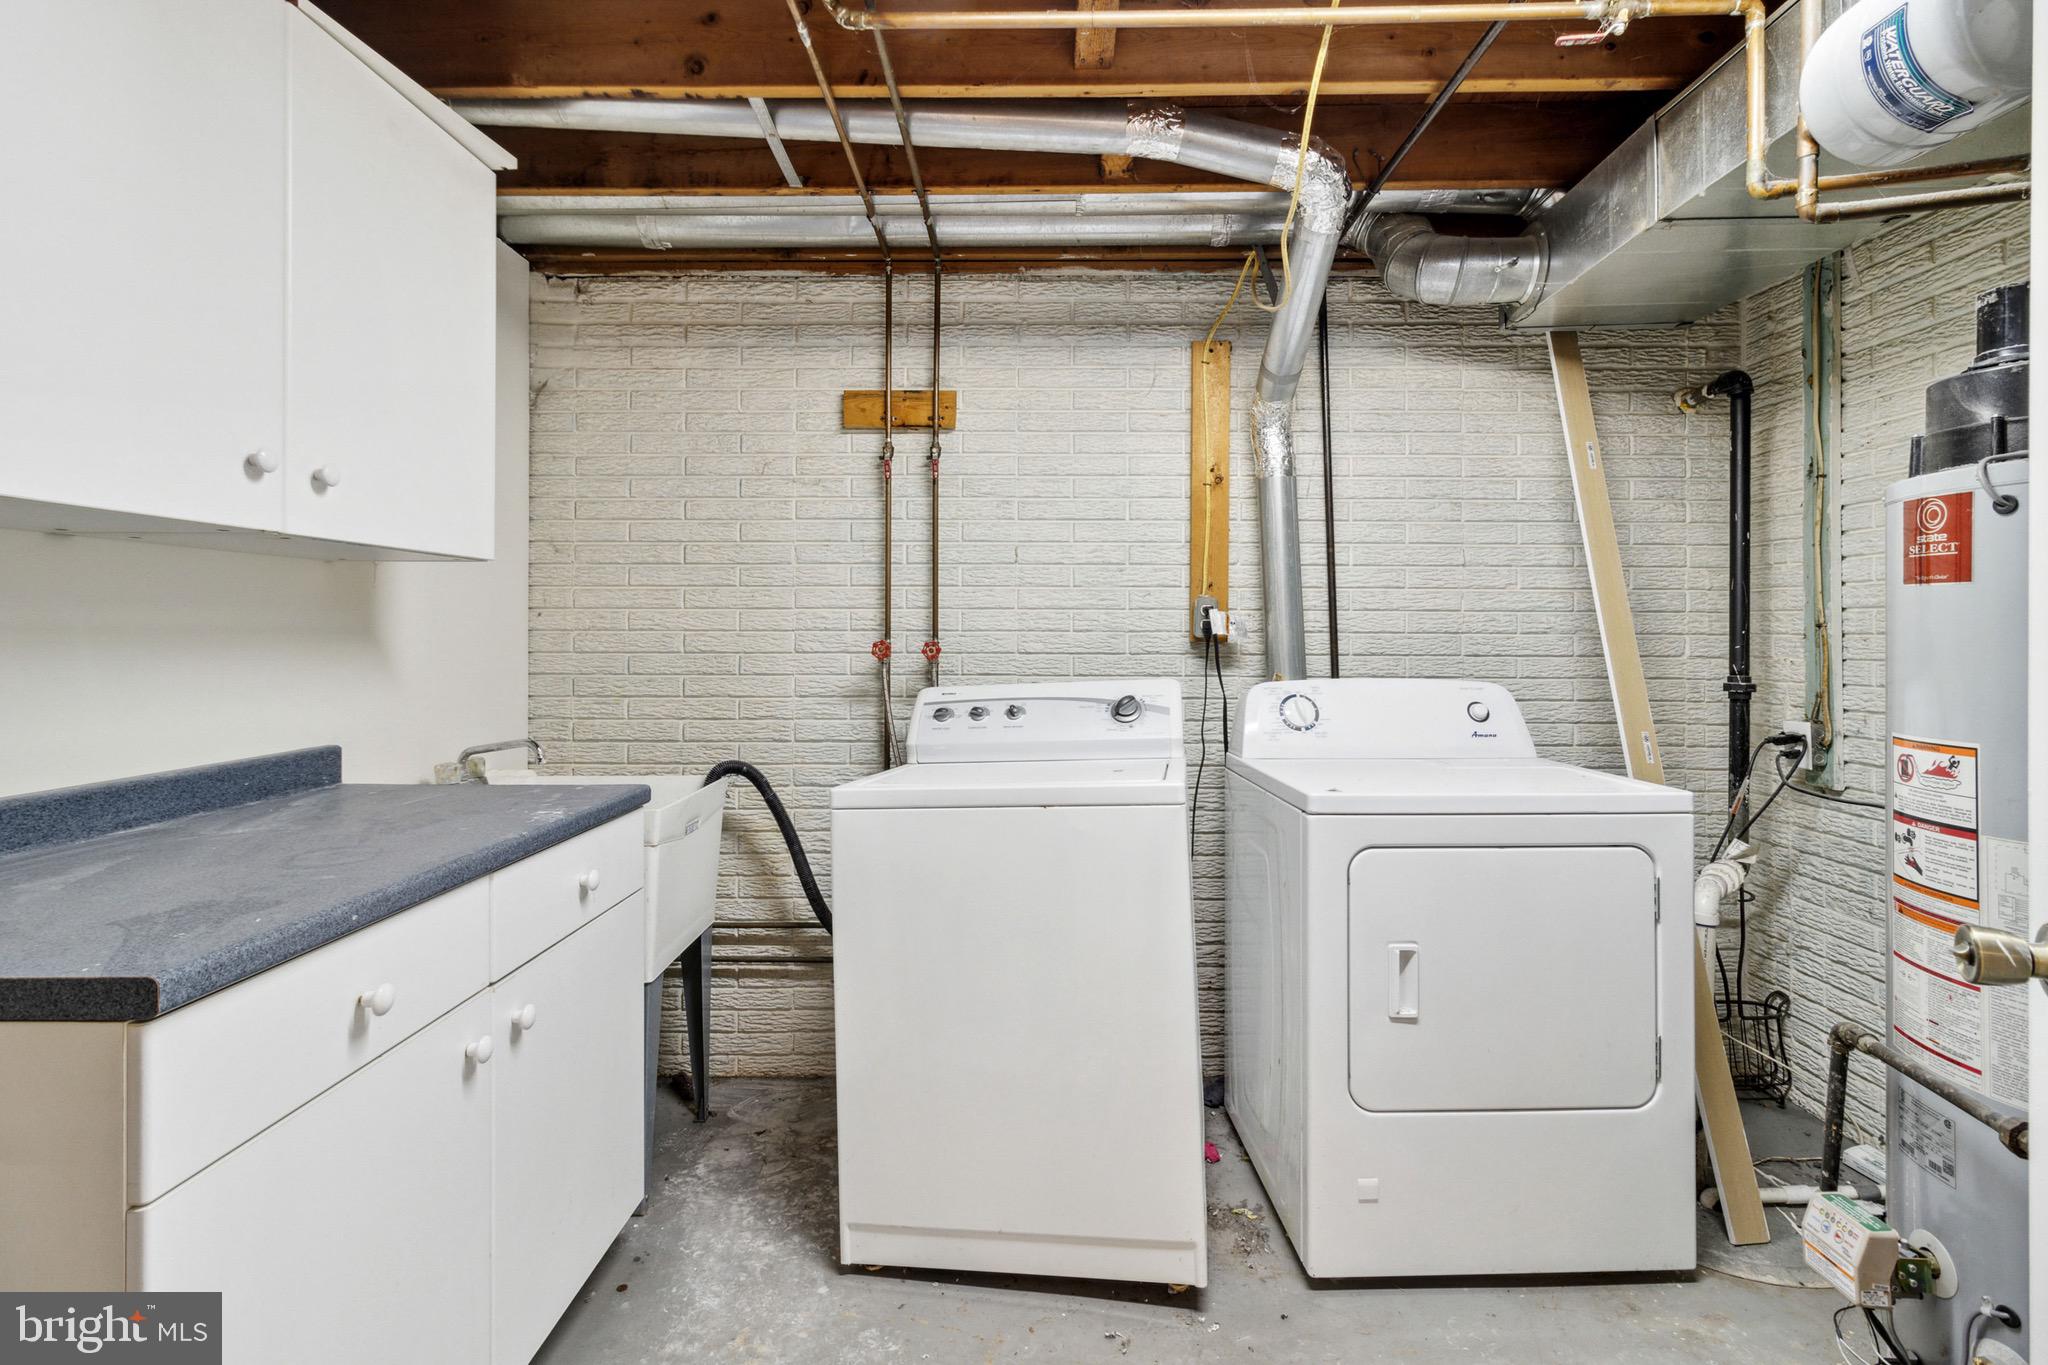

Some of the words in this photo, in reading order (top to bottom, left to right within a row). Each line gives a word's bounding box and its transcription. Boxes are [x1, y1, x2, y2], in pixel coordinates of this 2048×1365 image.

[1884, 26, 1954, 112] WATERGUARD
[1885, 60, 1898, 80] Water
[1896, 81, 1926, 109] Expansion
[1917, 533, 1948, 544] state
[1909, 542, 1958, 554] SELECT
[1917, 822, 1941, 832] DANGER
